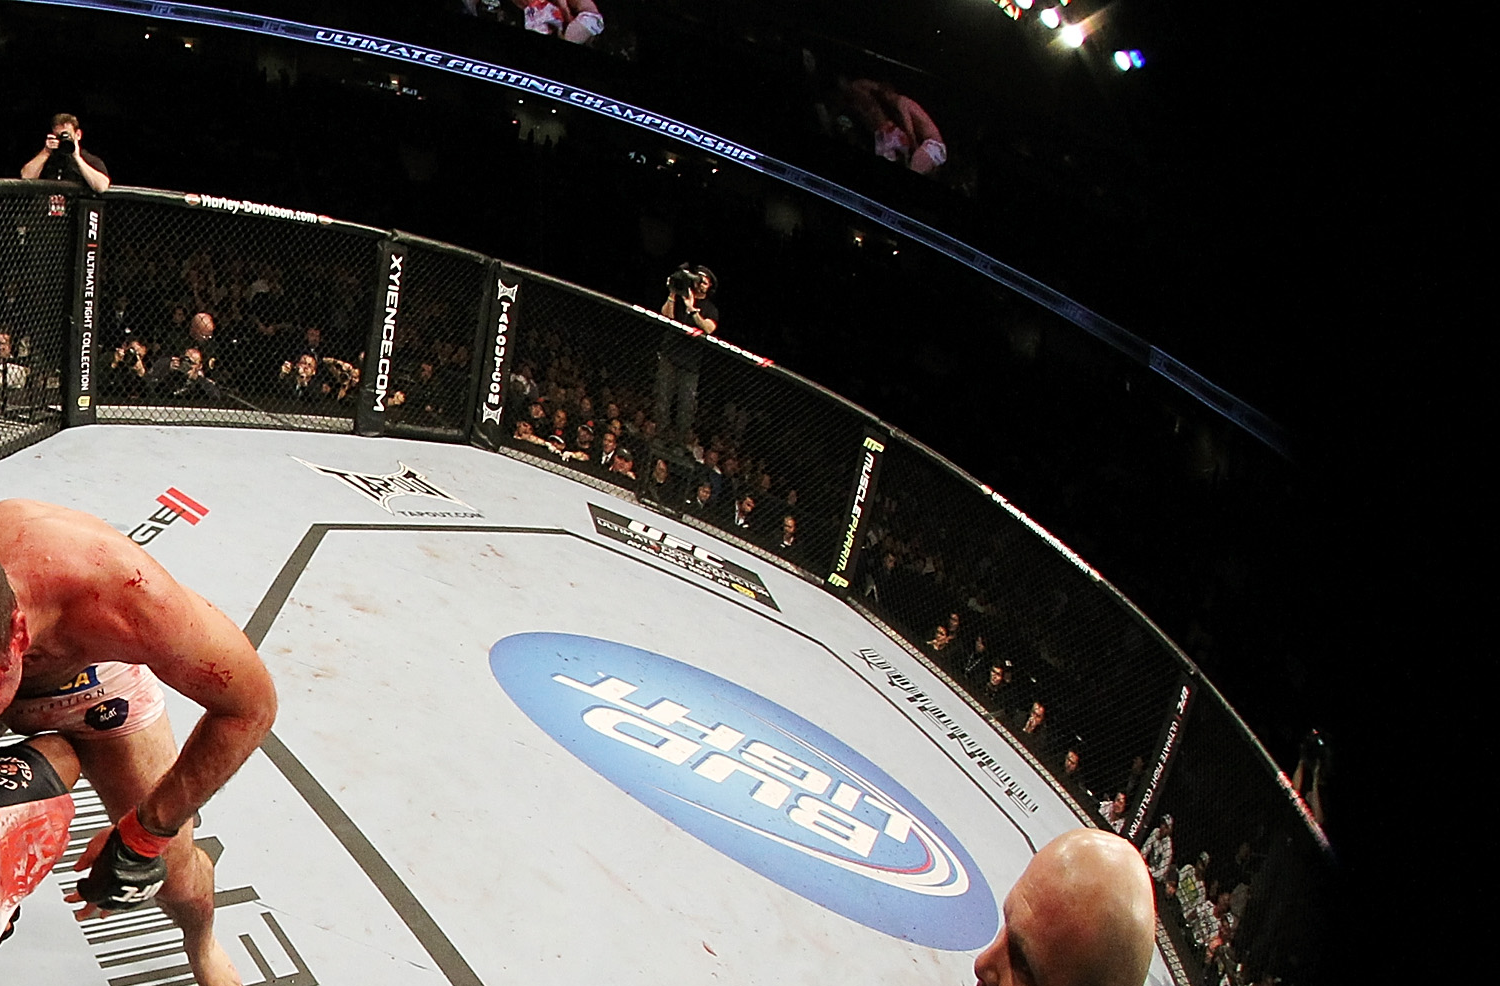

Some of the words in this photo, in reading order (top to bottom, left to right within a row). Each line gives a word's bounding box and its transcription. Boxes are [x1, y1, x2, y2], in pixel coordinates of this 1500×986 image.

[315, 30, 442, 64] ULTIMATE
[446, 58, 564, 97] FIGHTING
[569, 91, 757, 161] CHAMPIONSHIP
[87, 210, 99, 241] UFC
[200, 194, 318, 224] Harley-Davidson.com
[84, 250, 96, 298] ULTIMATE
[83, 300, 93, 330] FIGHT
[373, 253, 404, 413] XYIENCE.COM
[80, 331, 92, 391] COLLECTION
[486, 301, 511, 406] TAPOUT.COM
[397, 510, 486, 519] TAPOUT.COM
[627, 519, 725, 568] UFC
[1176, 685, 1190, 715] UFC
[551, 671, 914, 844] LIGHT
[1159, 721, 1180, 765] ULTIMATE
[581, 705, 879, 858] BUD
[1150, 761, 1166, 790] FIGHT
[1128, 787, 1154, 840] COLLECTION
[111, 880, 164, 902] UFC
